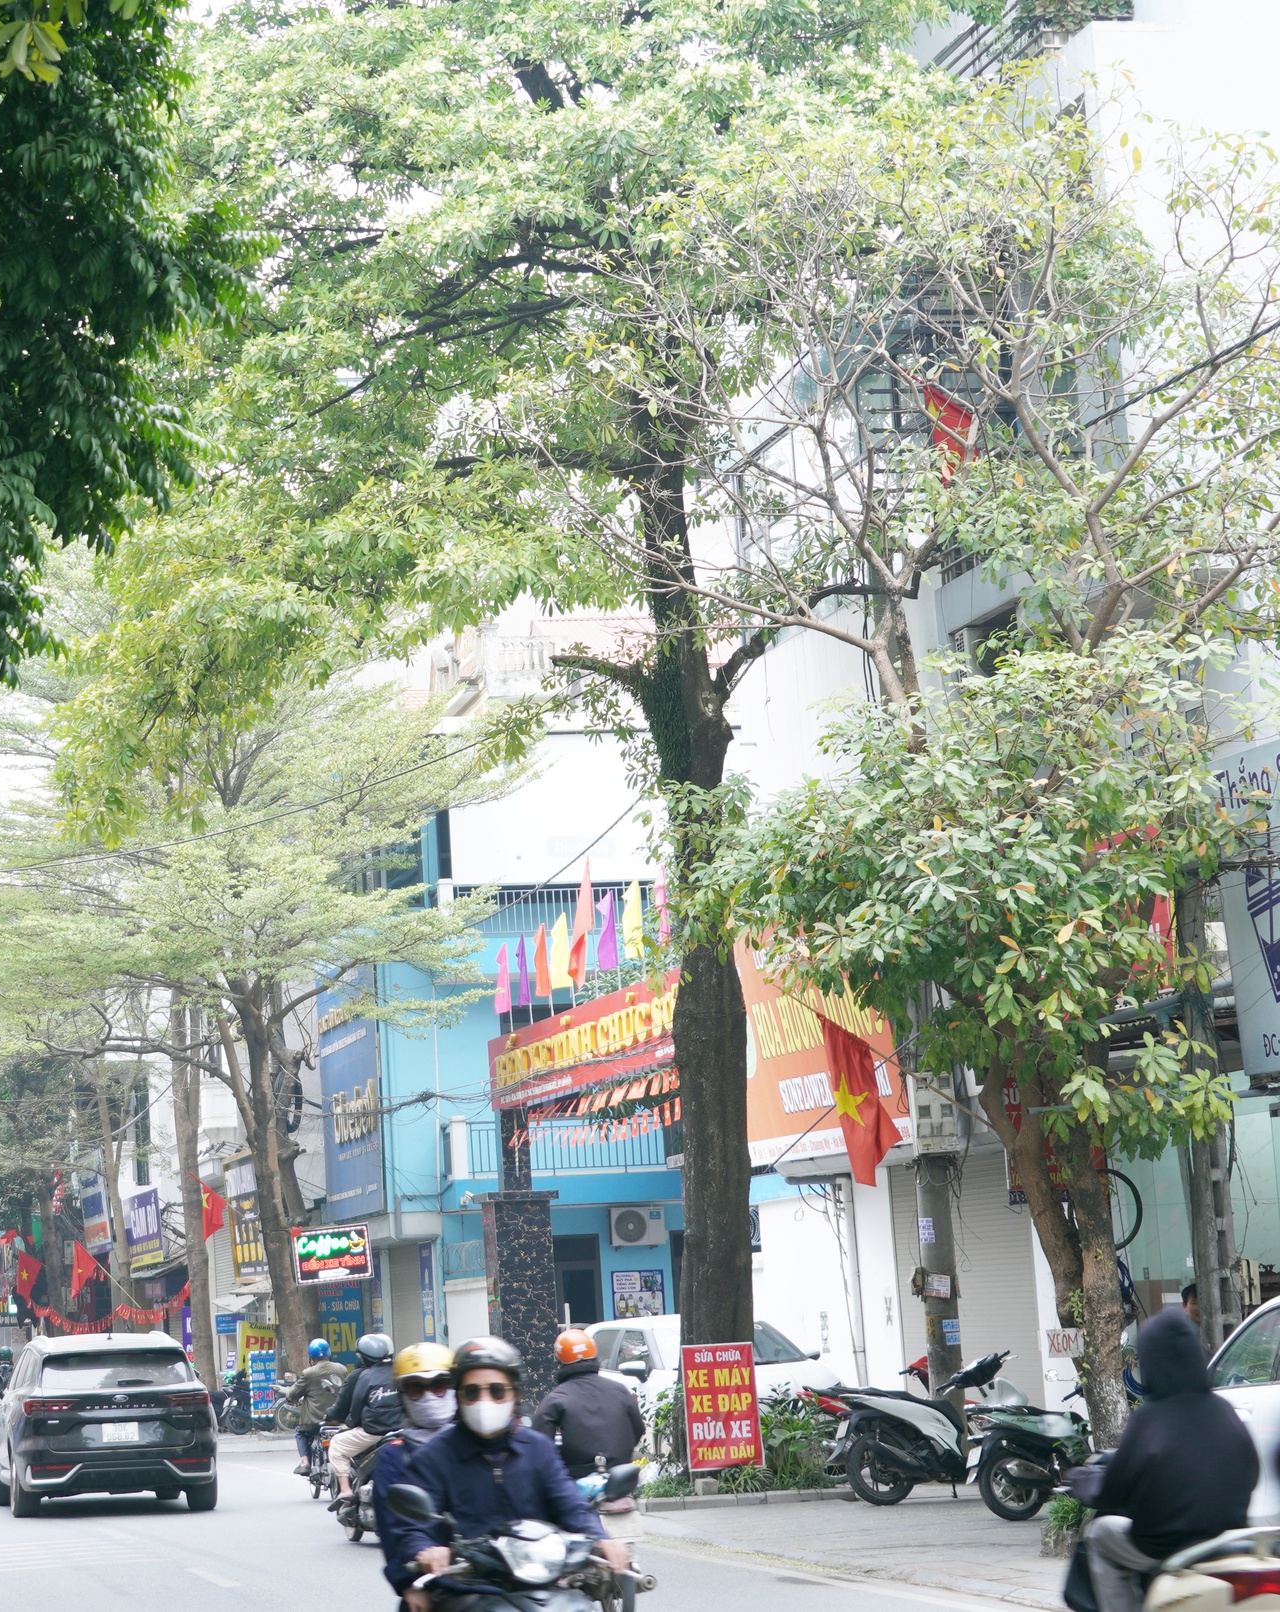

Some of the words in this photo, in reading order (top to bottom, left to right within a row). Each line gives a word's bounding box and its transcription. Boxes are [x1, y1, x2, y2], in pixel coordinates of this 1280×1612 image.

[496, 1034, 530, 1088] BẾN
[528, 1038, 552, 1070] XE
[551, 1015, 596, 1067] TỈNH
[597, 992, 650, 1055] CHÚC
[651, 983, 678, 1037] SƠ
[752, 999, 785, 1059] HOA
[778, 1072, 836, 1114] SUNFLOWER
[130, 1198, 147, 1239] CẦM
[147, 1193, 158, 1235] ĐỒ
[298, 1235, 349, 1257] Coffee
[302, 1256, 324, 1271] BẾN
[325, 1258, 339, 1268] XE
[332, 1298, 343, 1311] SỬA
[344, 1298, 360, 1311] CHỮA
[322, 1317, 356, 1358] IỆN
[253, 1360, 265, 1370] SỬA
[695, 1349, 713, 1363] SỬA
[716, 1349, 741, 1362] CHỮA
[252, 1372, 266, 1380] MUA
[687, 1370, 709, 1388] XE
[714, 1364, 751, 1387] MÁY
[691, 1395, 713, 1413] XE
[718, 1392, 752, 1415] ĐẠP
[112, 1424, 128, 1432] 30K
[692, 1417, 726, 1440] RỬA
[730, 1420, 752, 1438] XE
[697, 1447, 726, 1461] THAY
[730, 1440, 755, 1459] DẦU
